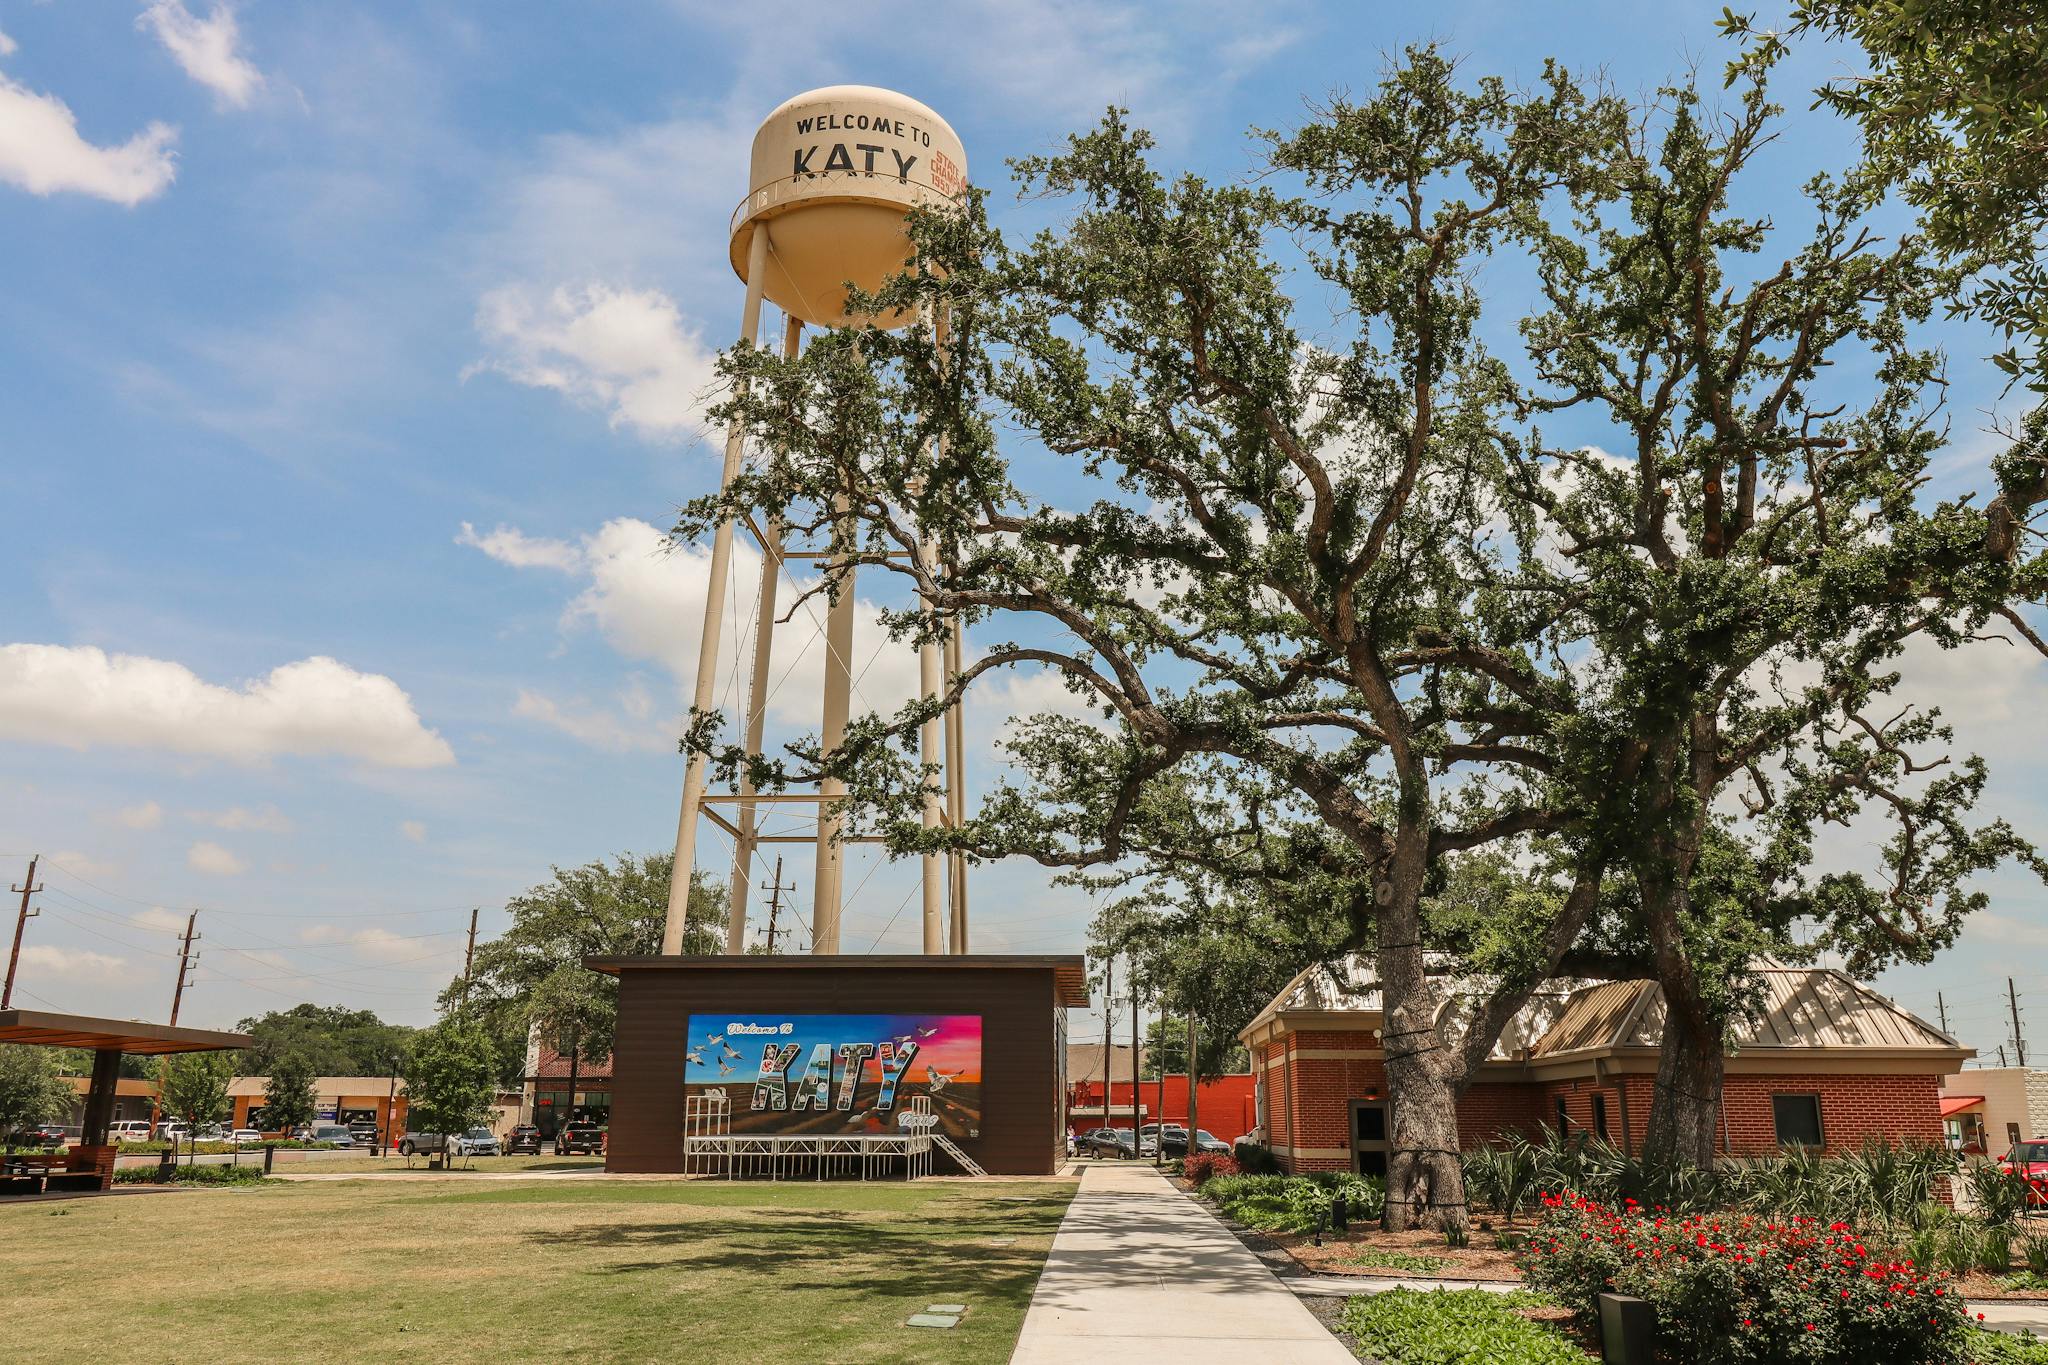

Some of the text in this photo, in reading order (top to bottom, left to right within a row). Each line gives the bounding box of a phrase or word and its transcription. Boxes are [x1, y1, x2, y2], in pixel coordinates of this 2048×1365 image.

[797, 114, 930, 148] WELCOME TO
[793, 143, 918, 185] KATY
[936, 150, 960, 181] STATE
[727, 1023, 794, 1035] Welcome To
[751, 1041, 919, 1111] KATY
